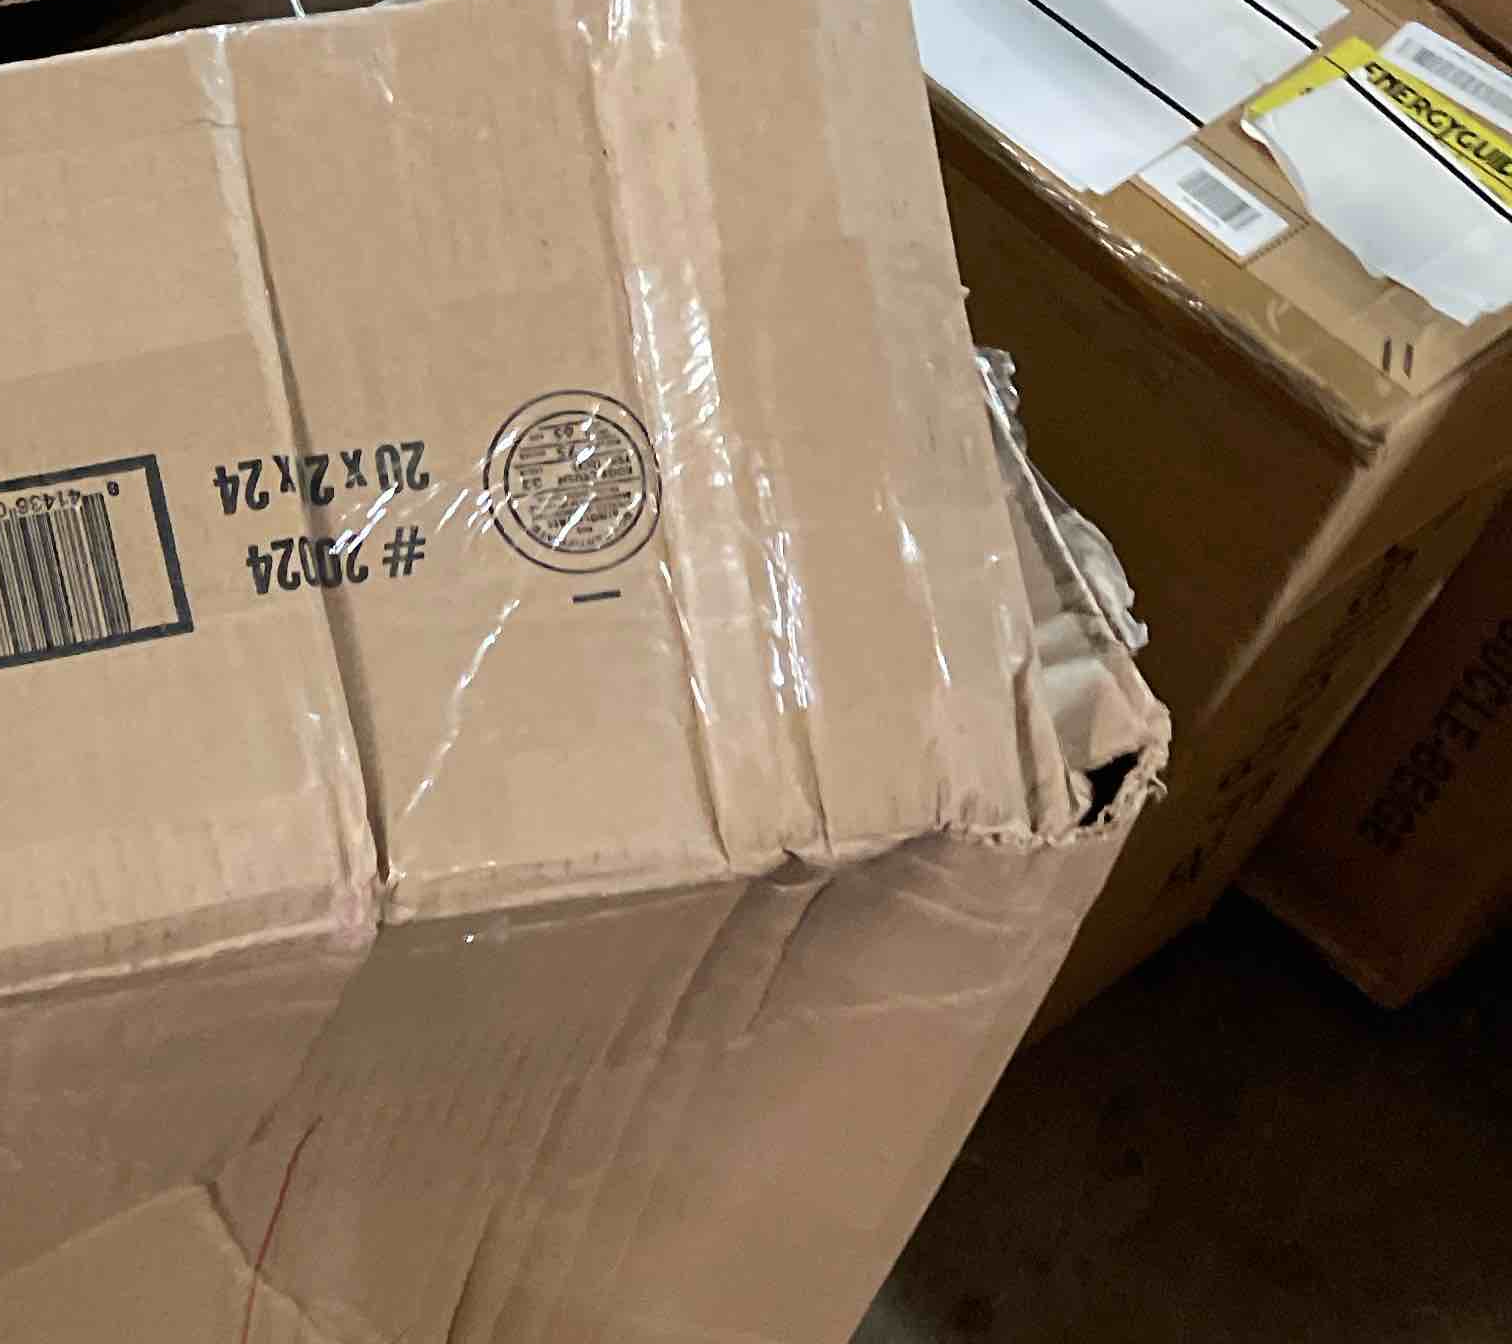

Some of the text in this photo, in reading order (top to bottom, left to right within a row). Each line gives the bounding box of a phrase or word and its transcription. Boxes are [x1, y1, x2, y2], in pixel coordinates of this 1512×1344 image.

[213, 459, 270, 515] 24
[305, 454, 335, 506] 2
[340, 449, 367, 489] x
[375, 440, 430, 494] 20
[382, 525, 426, 578] #
